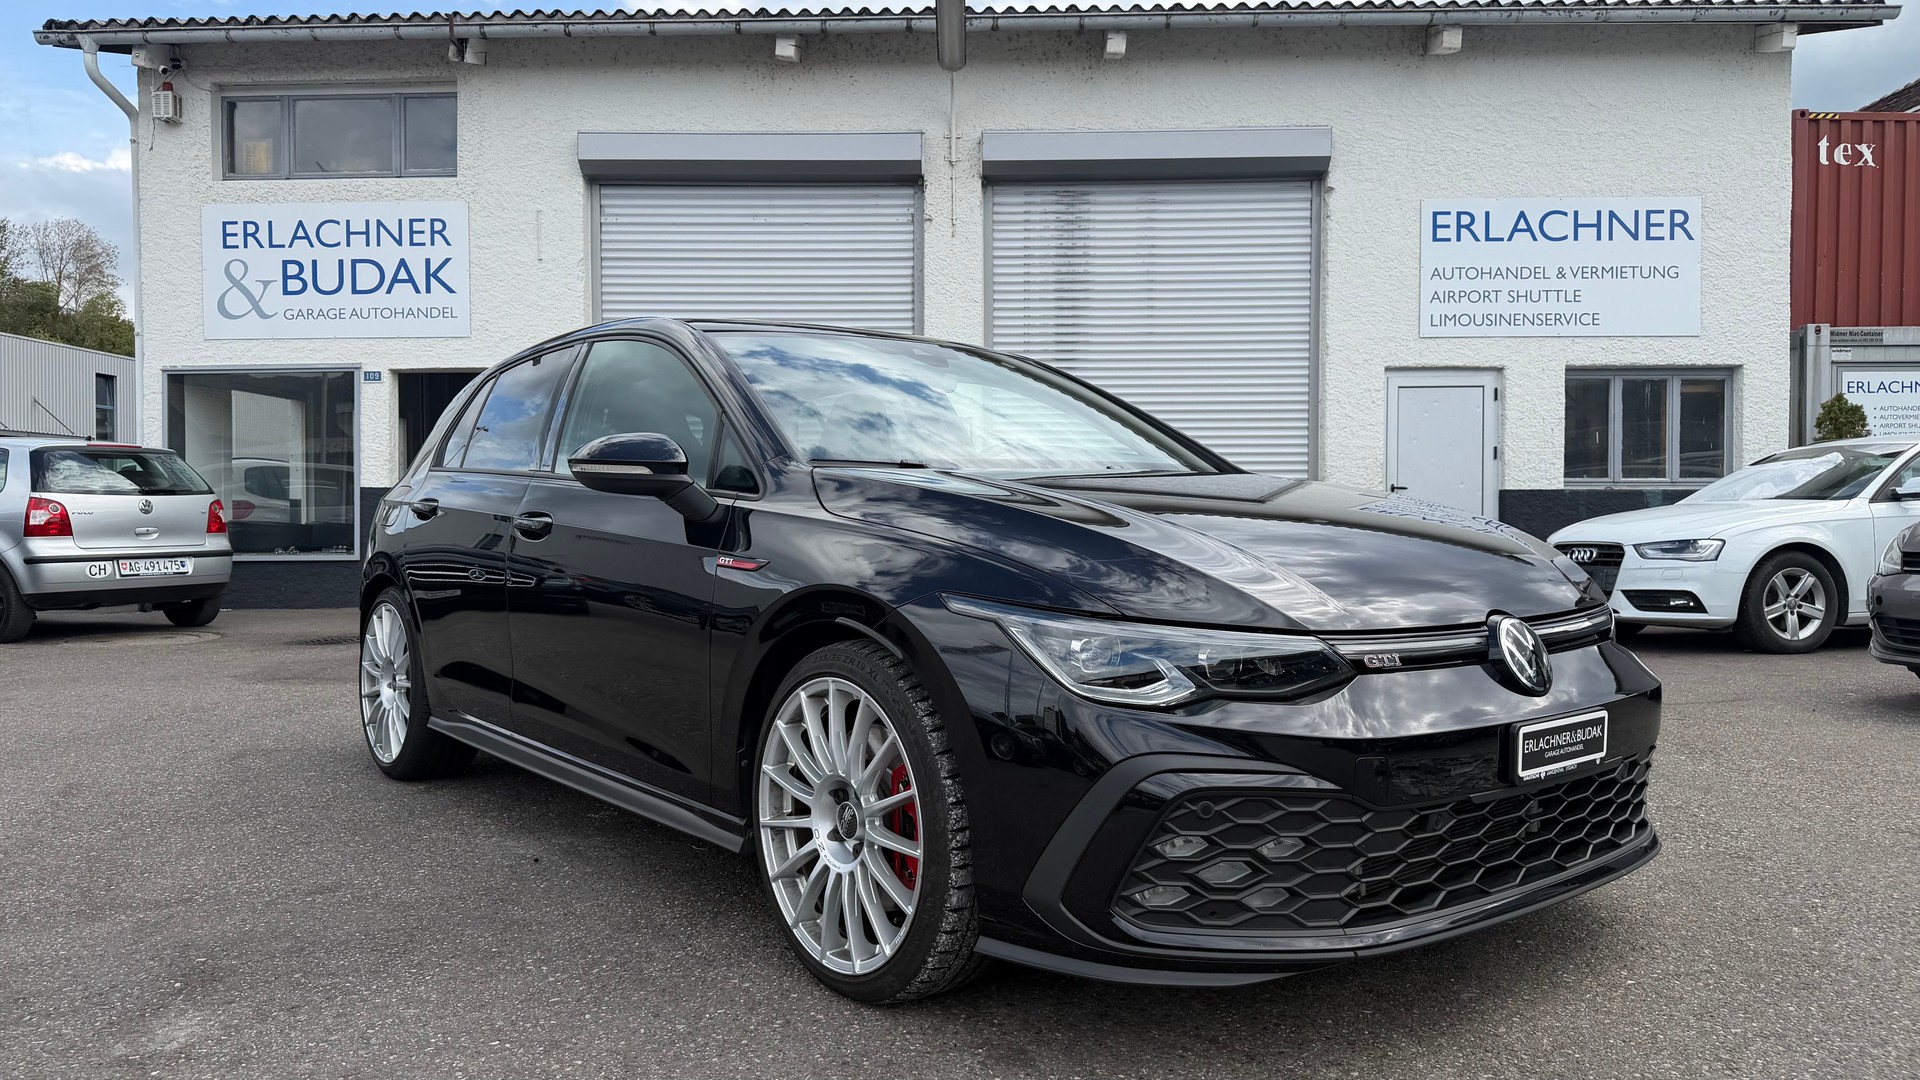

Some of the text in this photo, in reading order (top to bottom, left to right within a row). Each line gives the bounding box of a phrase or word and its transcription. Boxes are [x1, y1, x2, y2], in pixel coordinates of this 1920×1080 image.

[1817, 134, 1876, 167] tex
[221, 218, 453, 249] ERLACHNER
[1431, 209, 1696, 243] ERLACHNER
[1429, 265, 1680, 281] AUTOHANDEL & VERMIETUNG
[216, 257, 458, 321] & BUDAK
[1429, 289, 1582, 304] AIRPORT SHUTTLE
[283, 306, 459, 321] GARAGE AUTOHANDEL
[1430, 312, 1601, 328] LIMOUSINENSERVICE
[365, 372, 380, 380] 109
[719, 556, 734, 565] GTI
[88, 564, 107, 577] CH
[1363, 653, 1402, 668] GTI
[866, 668, 881, 682] XL
[1544, 743, 1585, 759] GARAGE AUTOHANDEL
